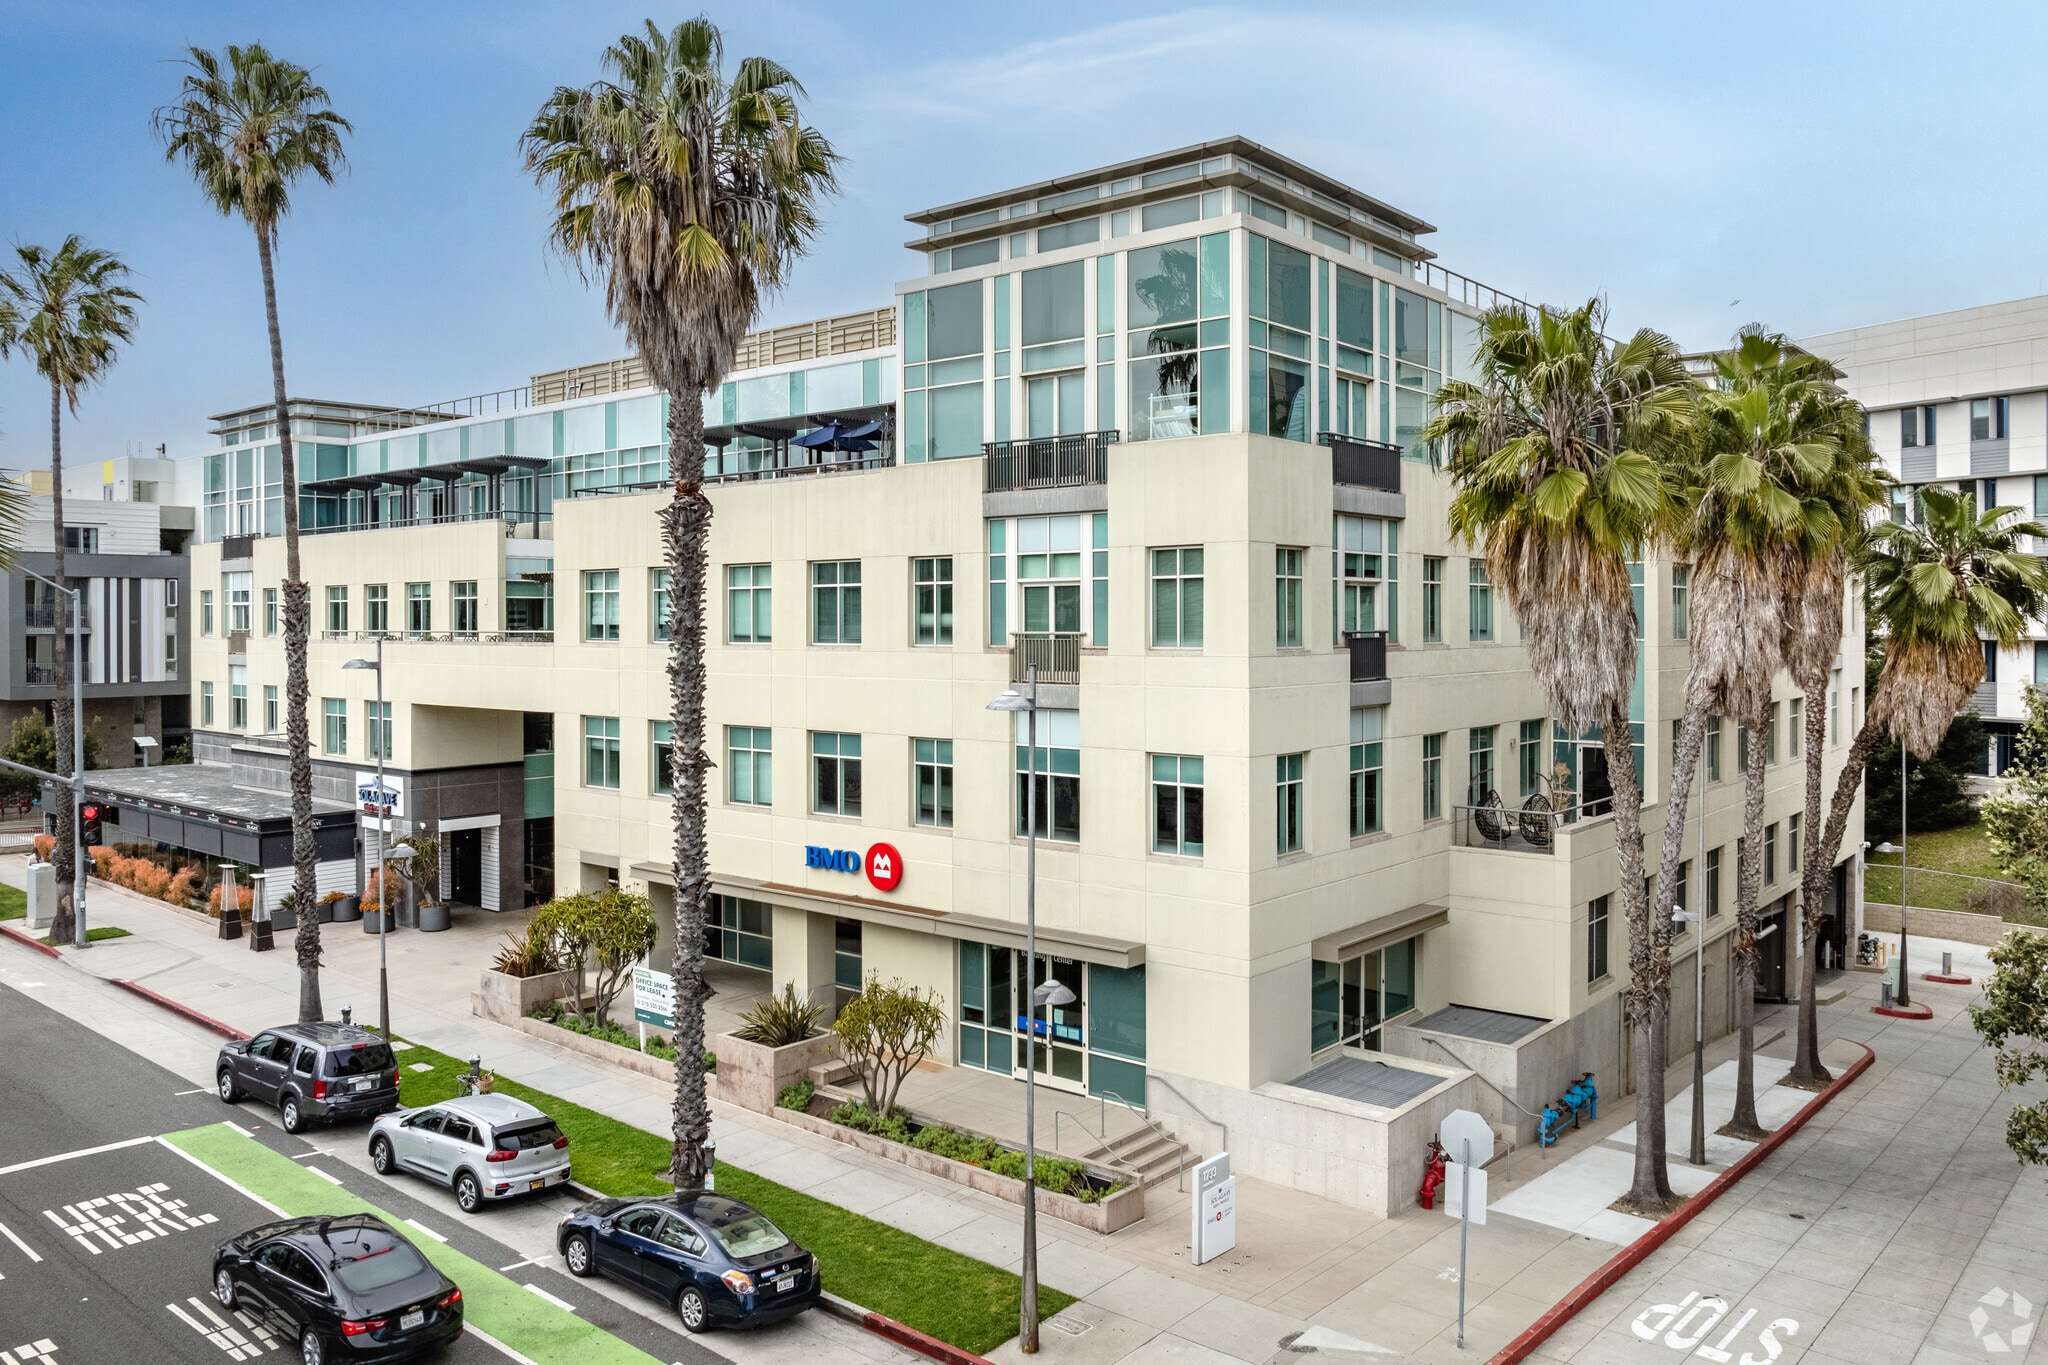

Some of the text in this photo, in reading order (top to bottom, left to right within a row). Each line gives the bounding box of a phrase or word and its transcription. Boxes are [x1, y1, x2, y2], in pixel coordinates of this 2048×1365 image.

[804, 845, 861, 874] BMO
[635, 977, 669, 991] OFFICE SPACE
[635, 984, 662, 996] FOR LEASE
[1202, 1166, 1217, 1182] 1733
[43, 1182, 220, 1255] HERE
[1631, 1290, 1800, 1365] STOP
